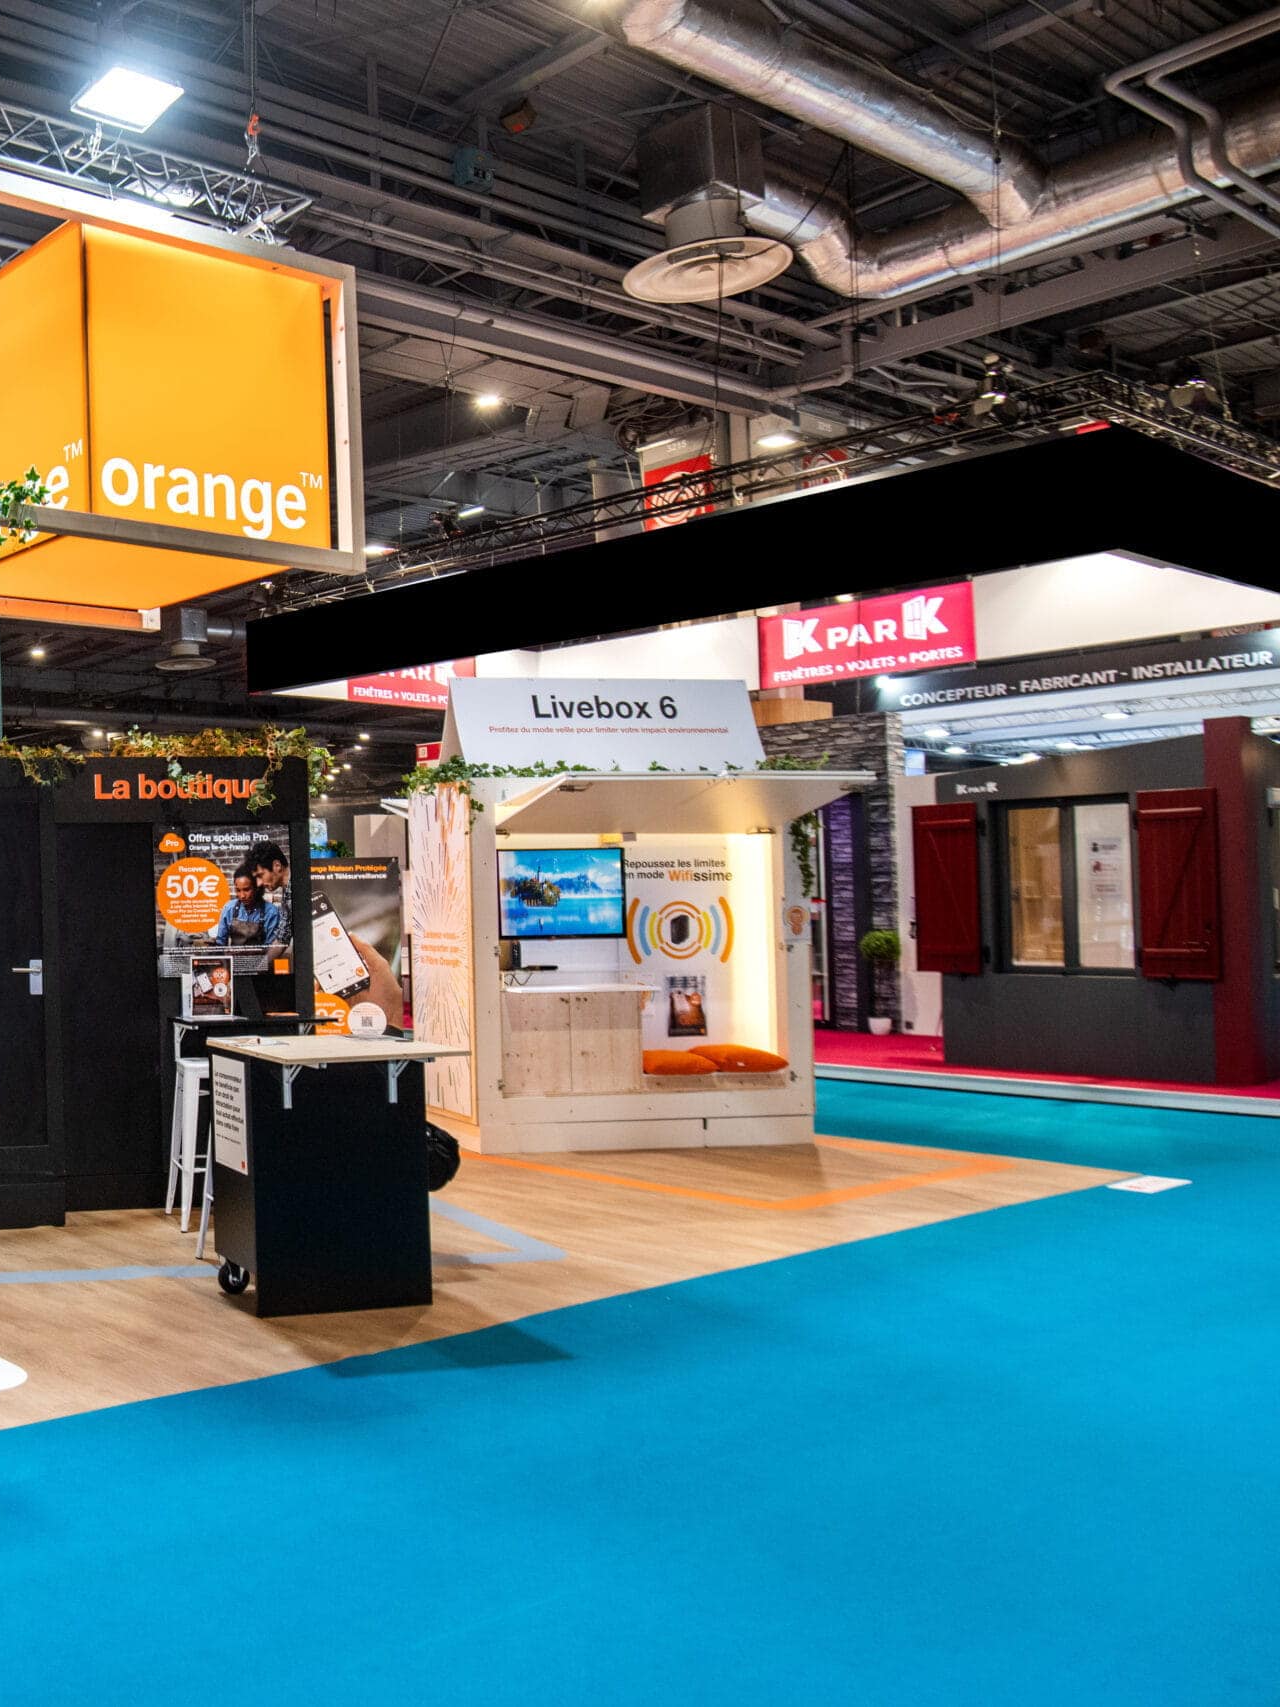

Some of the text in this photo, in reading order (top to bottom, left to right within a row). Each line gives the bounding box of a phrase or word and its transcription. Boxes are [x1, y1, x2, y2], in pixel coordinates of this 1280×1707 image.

[101, 457, 306, 540] orange
[827, 619, 898, 649] PAR
[773, 646, 963, 682] FENÊTRES VOLETS PORTES
[900, 651, 1273, 708] CONCEPTEUR FABRICANT INSTALLATEUR
[353, 686, 393, 699] FENÊTRES
[401, 692, 429, 703] VOLETS
[531, 694, 678, 719] Livebox 6
[489, 726, 519, 734] Profitez
[520, 726, 531, 734] du
[532, 726, 553, 734] mode
[556, 726, 574, 734] veille
[576, 727, 594, 735] pour
[595, 726, 619, 734] limiter
[641, 726, 666, 735] impact
[668, 726, 729, 734] environnemental
[94, 774, 131, 799] La
[188, 832, 269, 844] Offre spéciale Pro
[310, 864, 387, 874] ange Maison Protégée
[623, 859, 726, 869] Repoussez les limites
[637, 870, 665, 879] mode
[668, 870, 732, 881] Wifissime
[166, 875, 219, 898] 50€
